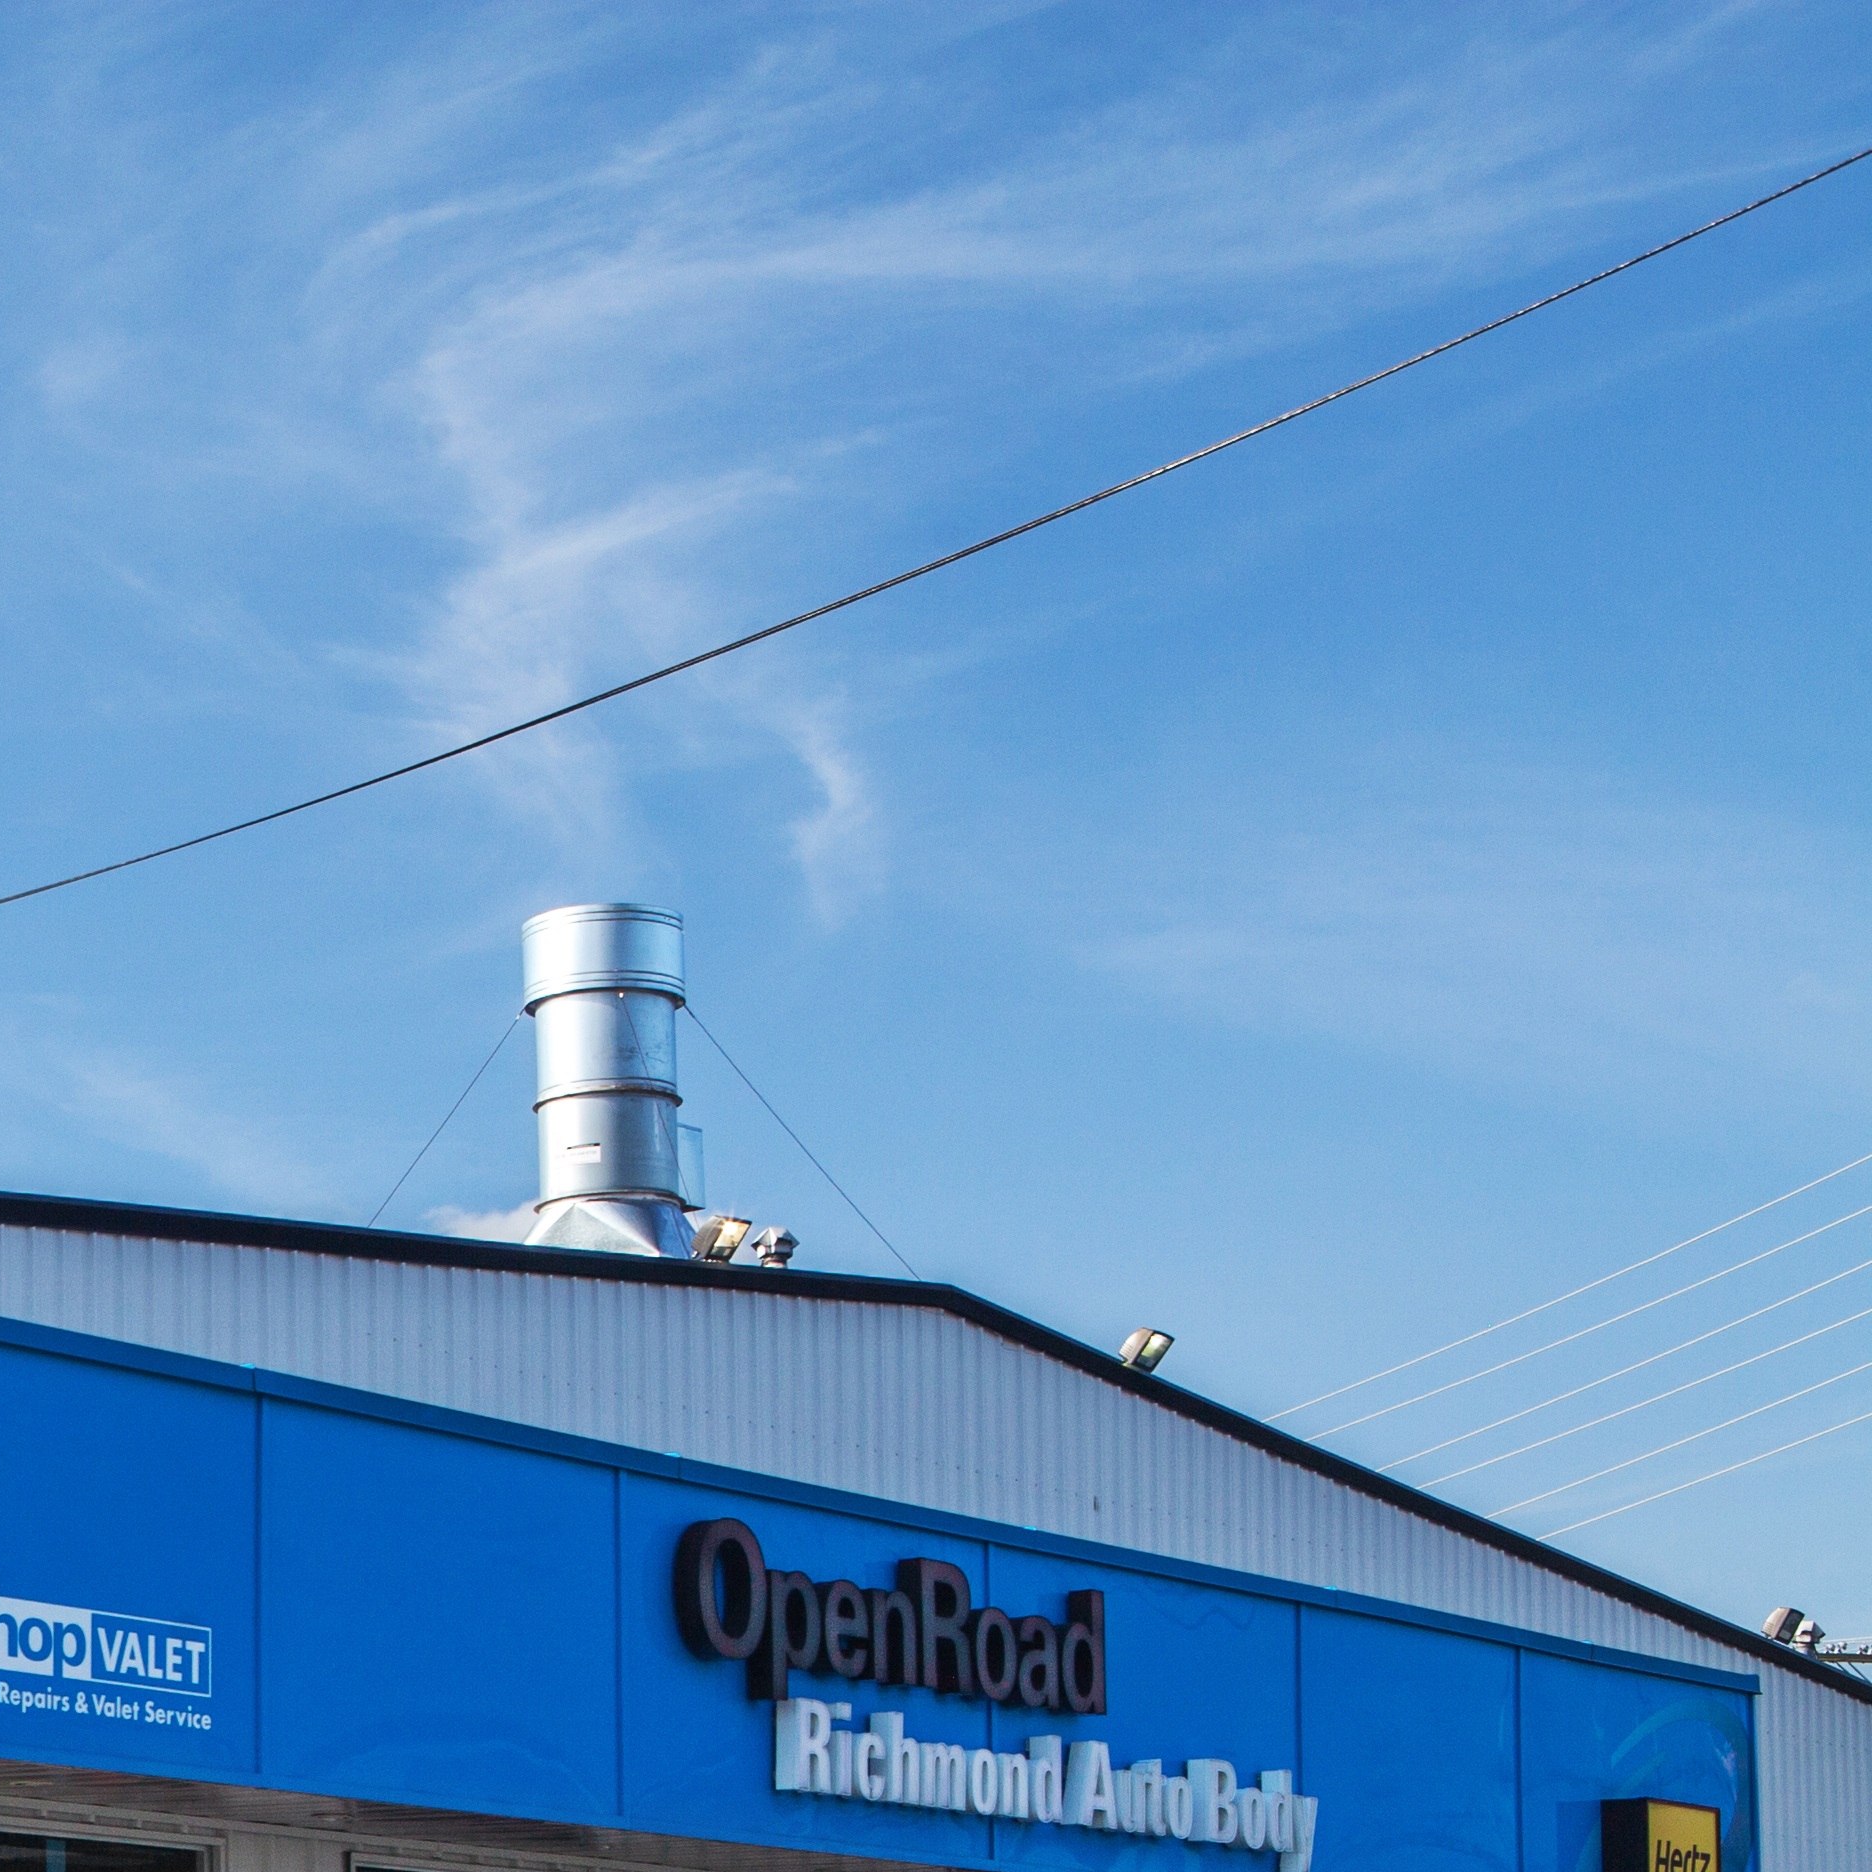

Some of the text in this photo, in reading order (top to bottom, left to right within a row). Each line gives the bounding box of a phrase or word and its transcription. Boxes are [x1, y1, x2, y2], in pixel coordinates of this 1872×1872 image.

[97, 1626, 206, 1684] VALET
[674, 1518, 1107, 1715] OpenRoad
[74, 1691, 89, 1714] &
[92, 1693, 140, 1720] Valet
[144, 1700, 212, 1731] Service
[775, 1697, 1062, 1825] Richmond
[1062, 1740, 1193, 1840] Auto
